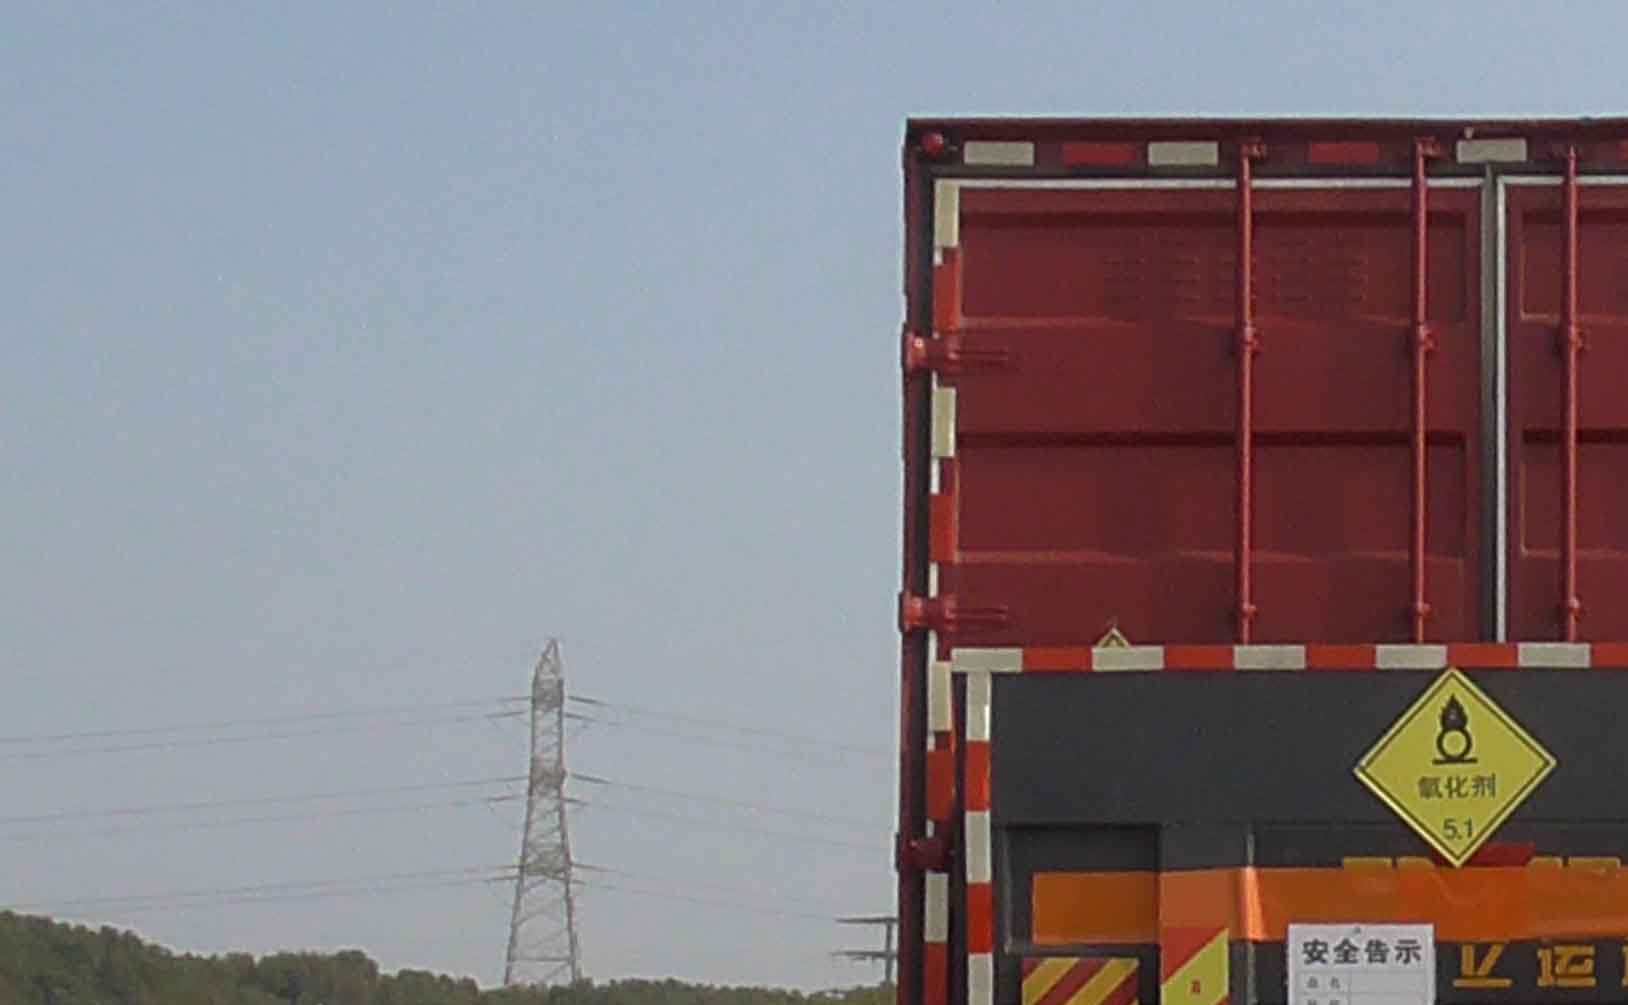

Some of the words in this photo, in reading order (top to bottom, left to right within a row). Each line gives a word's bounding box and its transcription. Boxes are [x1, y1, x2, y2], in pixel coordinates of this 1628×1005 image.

[1443, 818, 1473, 840] 5.1
[1302, 938, 1421, 965] 安全告示
